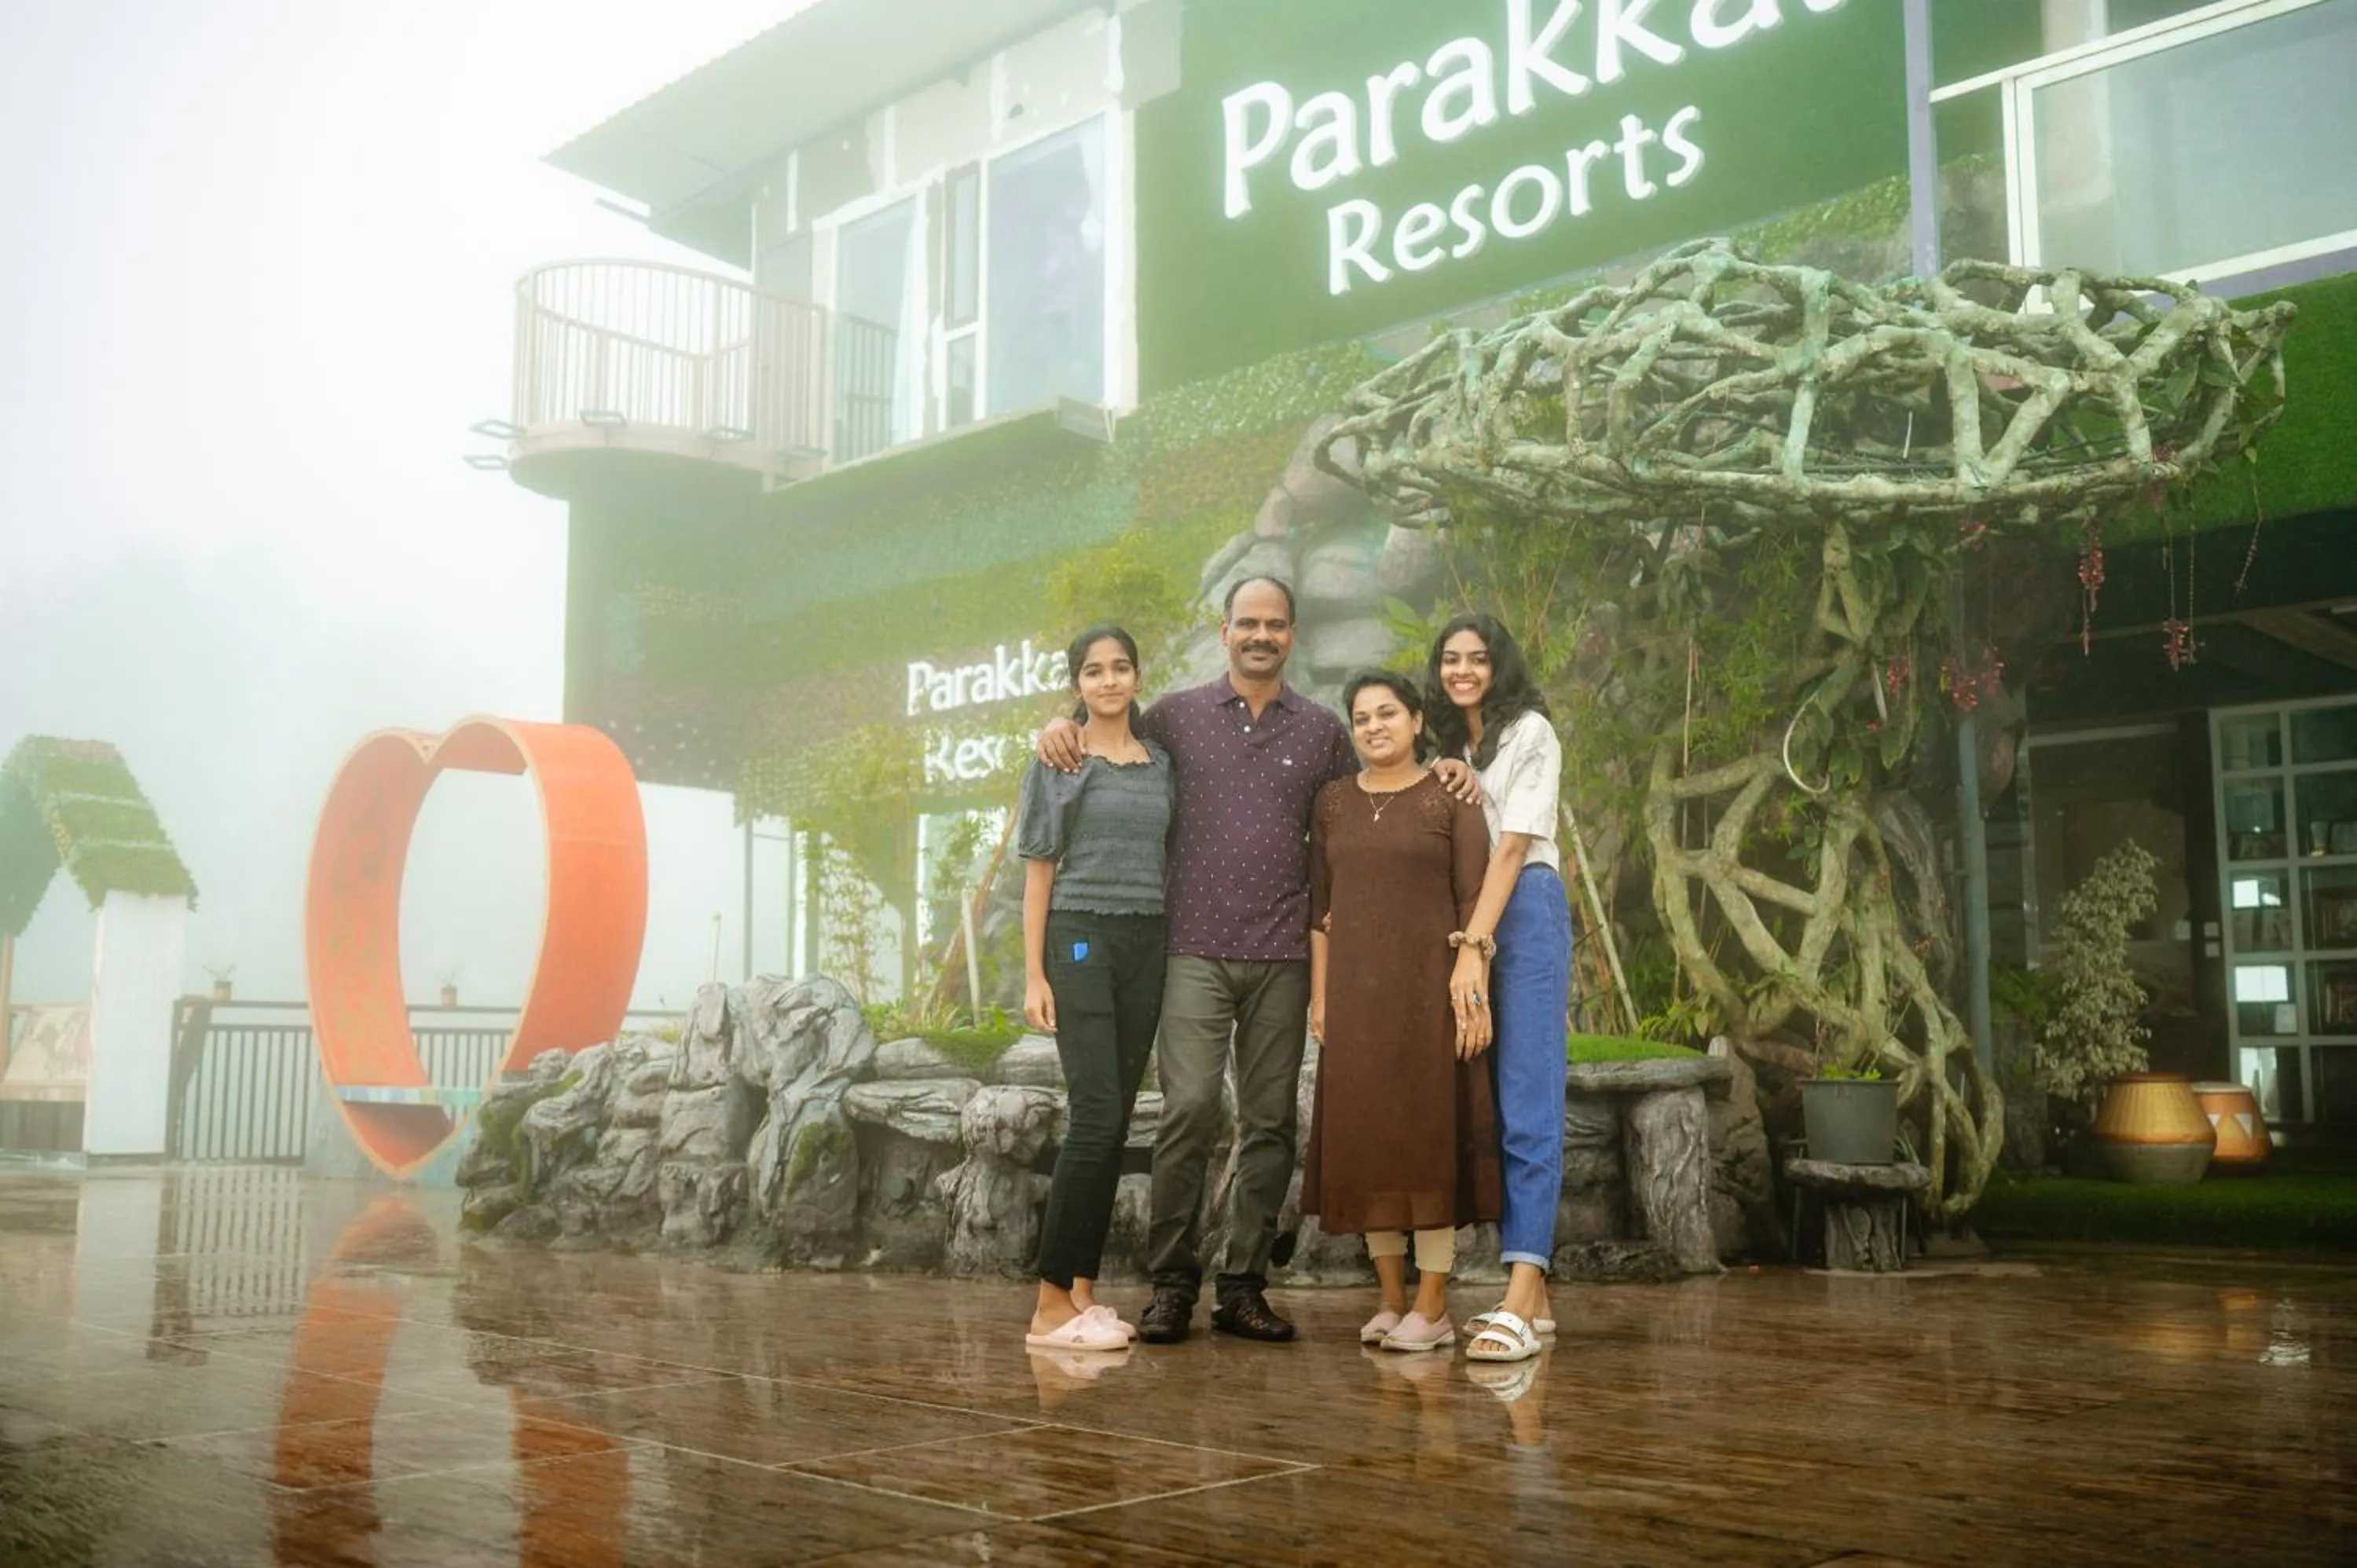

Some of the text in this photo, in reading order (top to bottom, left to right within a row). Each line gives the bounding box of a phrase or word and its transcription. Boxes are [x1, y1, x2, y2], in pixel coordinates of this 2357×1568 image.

[1222, 0, 1845, 219] Parakka
[1328, 105, 1705, 295] Resorts
[907, 639, 1071, 716] Parakka
